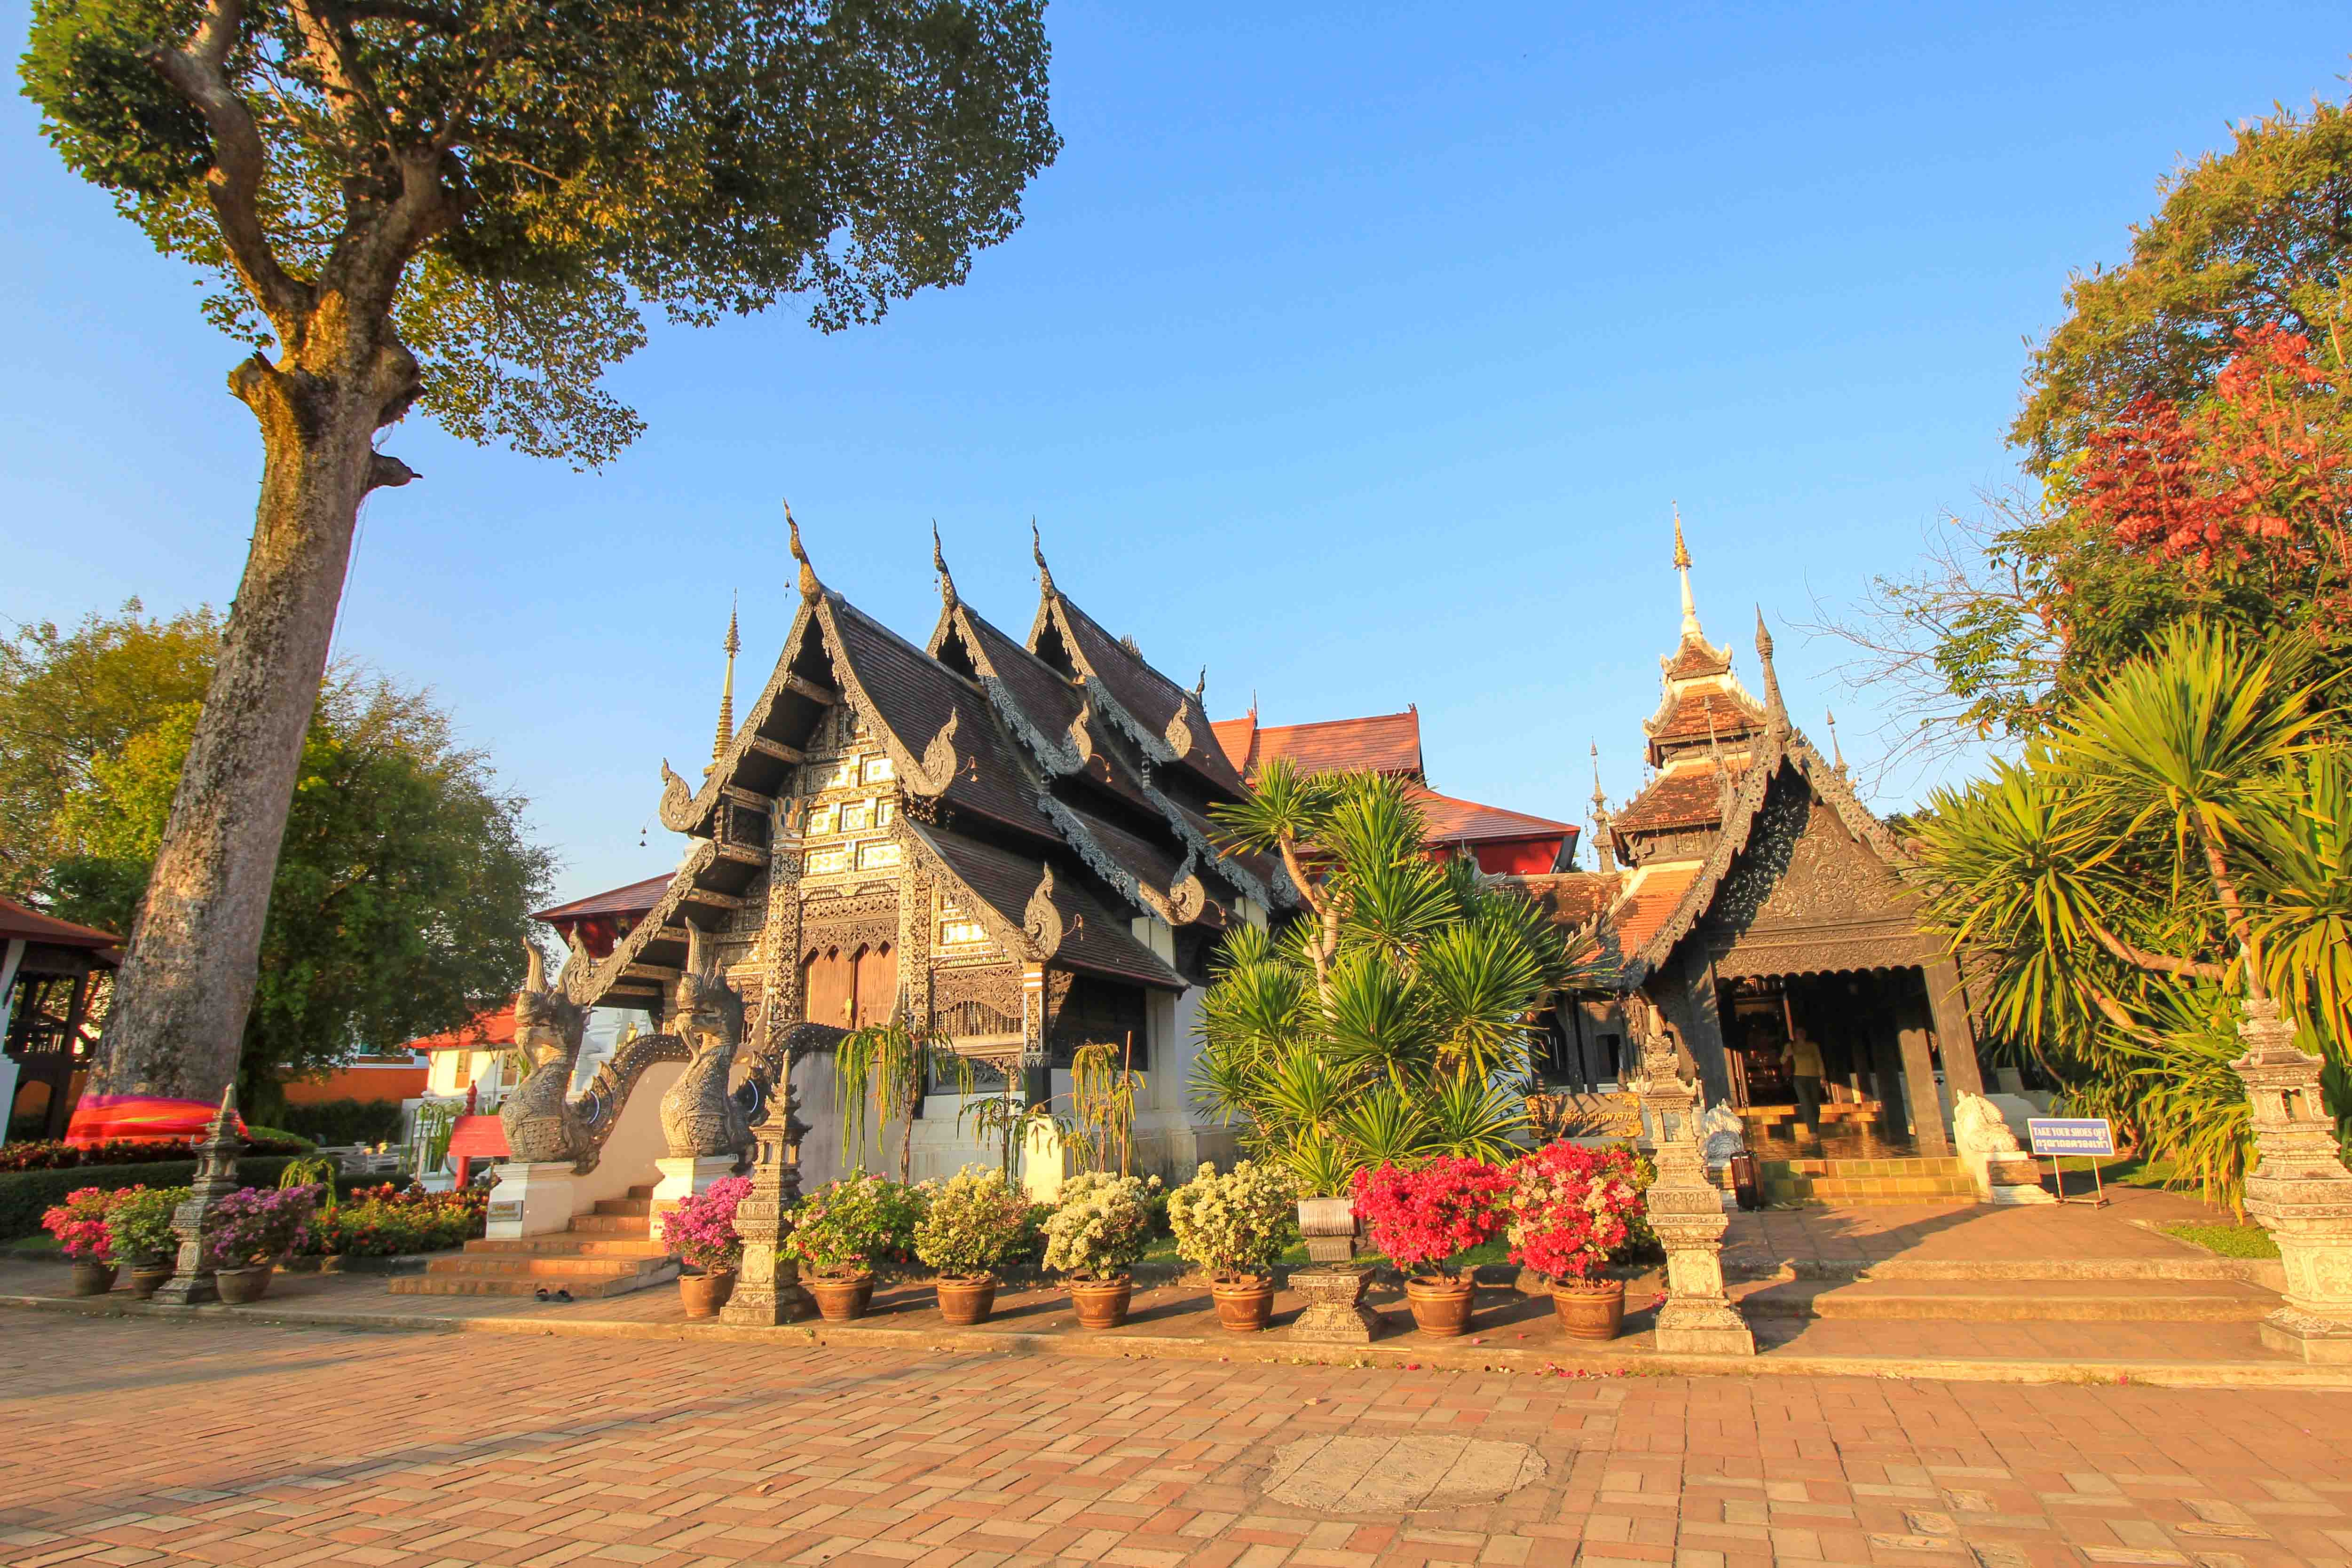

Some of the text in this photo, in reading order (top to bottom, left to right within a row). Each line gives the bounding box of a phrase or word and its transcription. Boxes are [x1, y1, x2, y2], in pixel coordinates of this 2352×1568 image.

[2033, 1127, 2107, 1137] TAKE YOUR SHOES OFF
